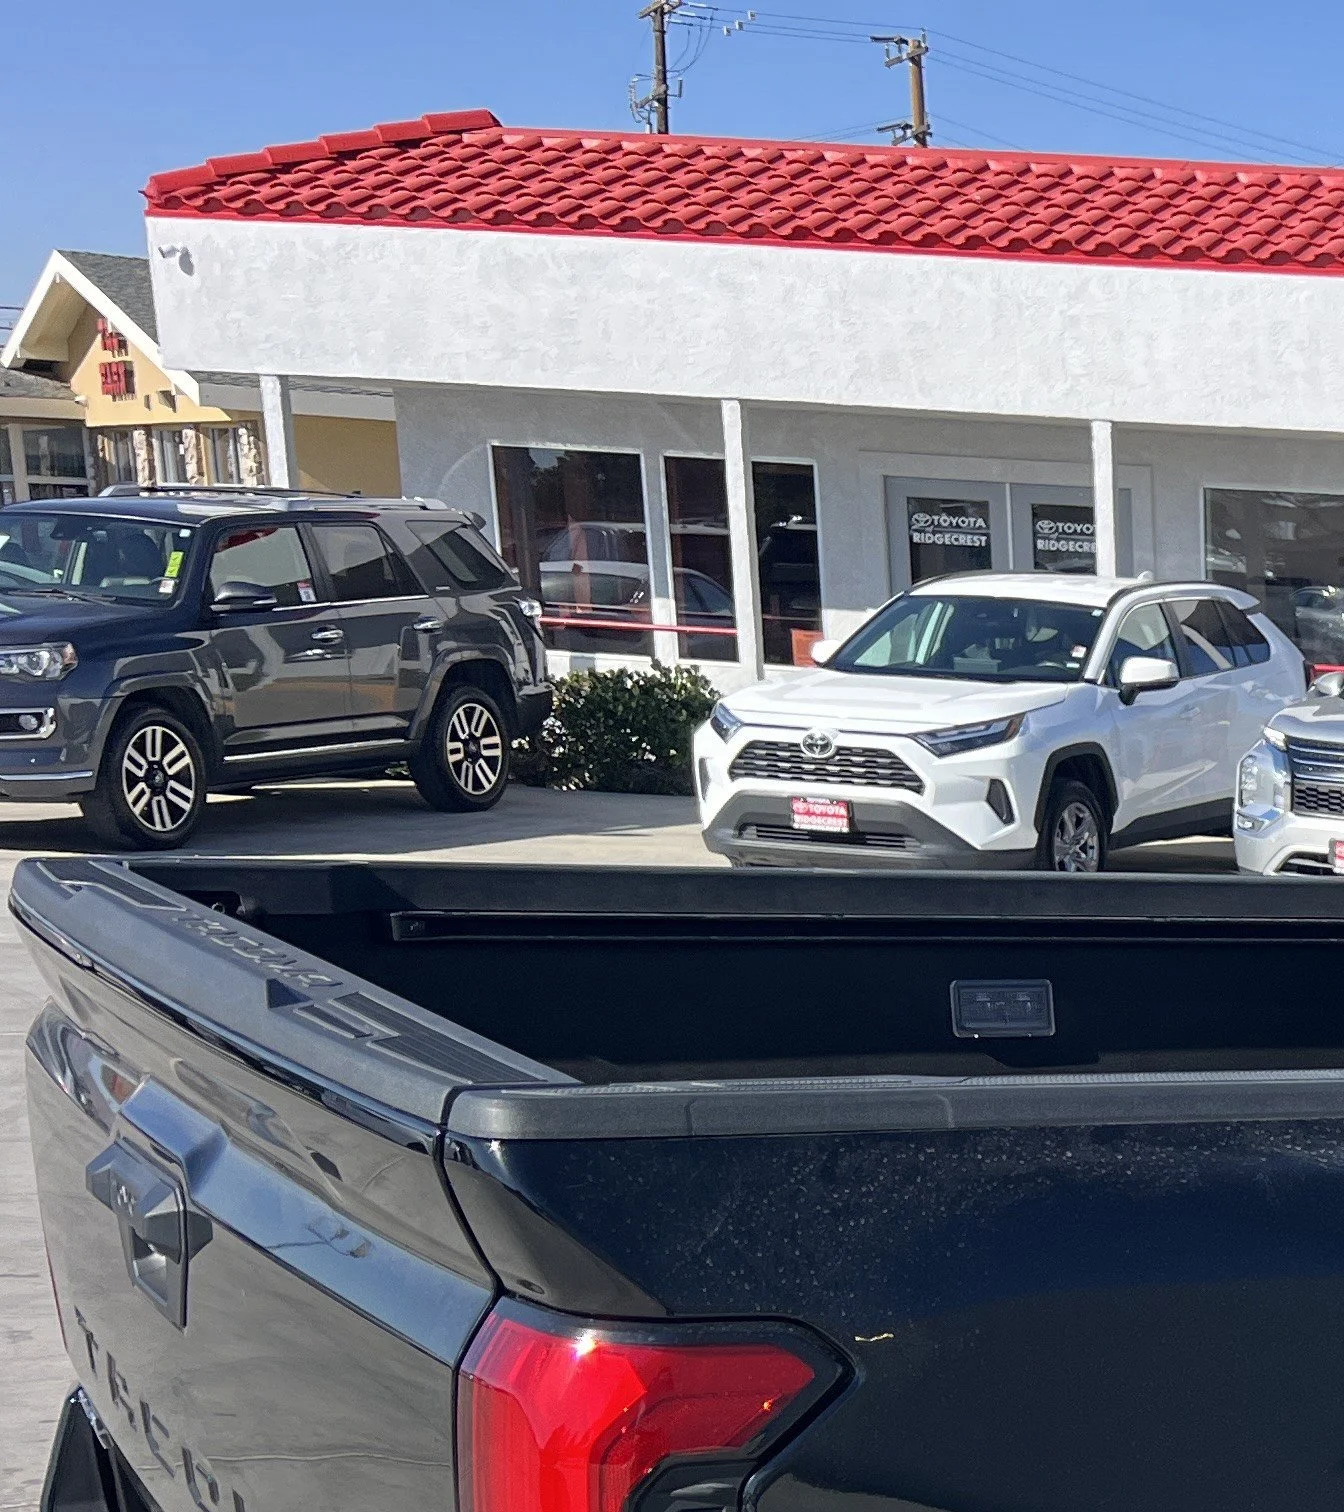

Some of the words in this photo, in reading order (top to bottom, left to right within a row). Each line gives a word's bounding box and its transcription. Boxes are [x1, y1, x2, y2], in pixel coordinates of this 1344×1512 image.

[932, 514, 987, 528] TOYOTA
[1056, 522, 1095, 535] TOYO
[912, 532, 987, 547] RIDGECREST
[1037, 539, 1096, 553] RIDGECRE
